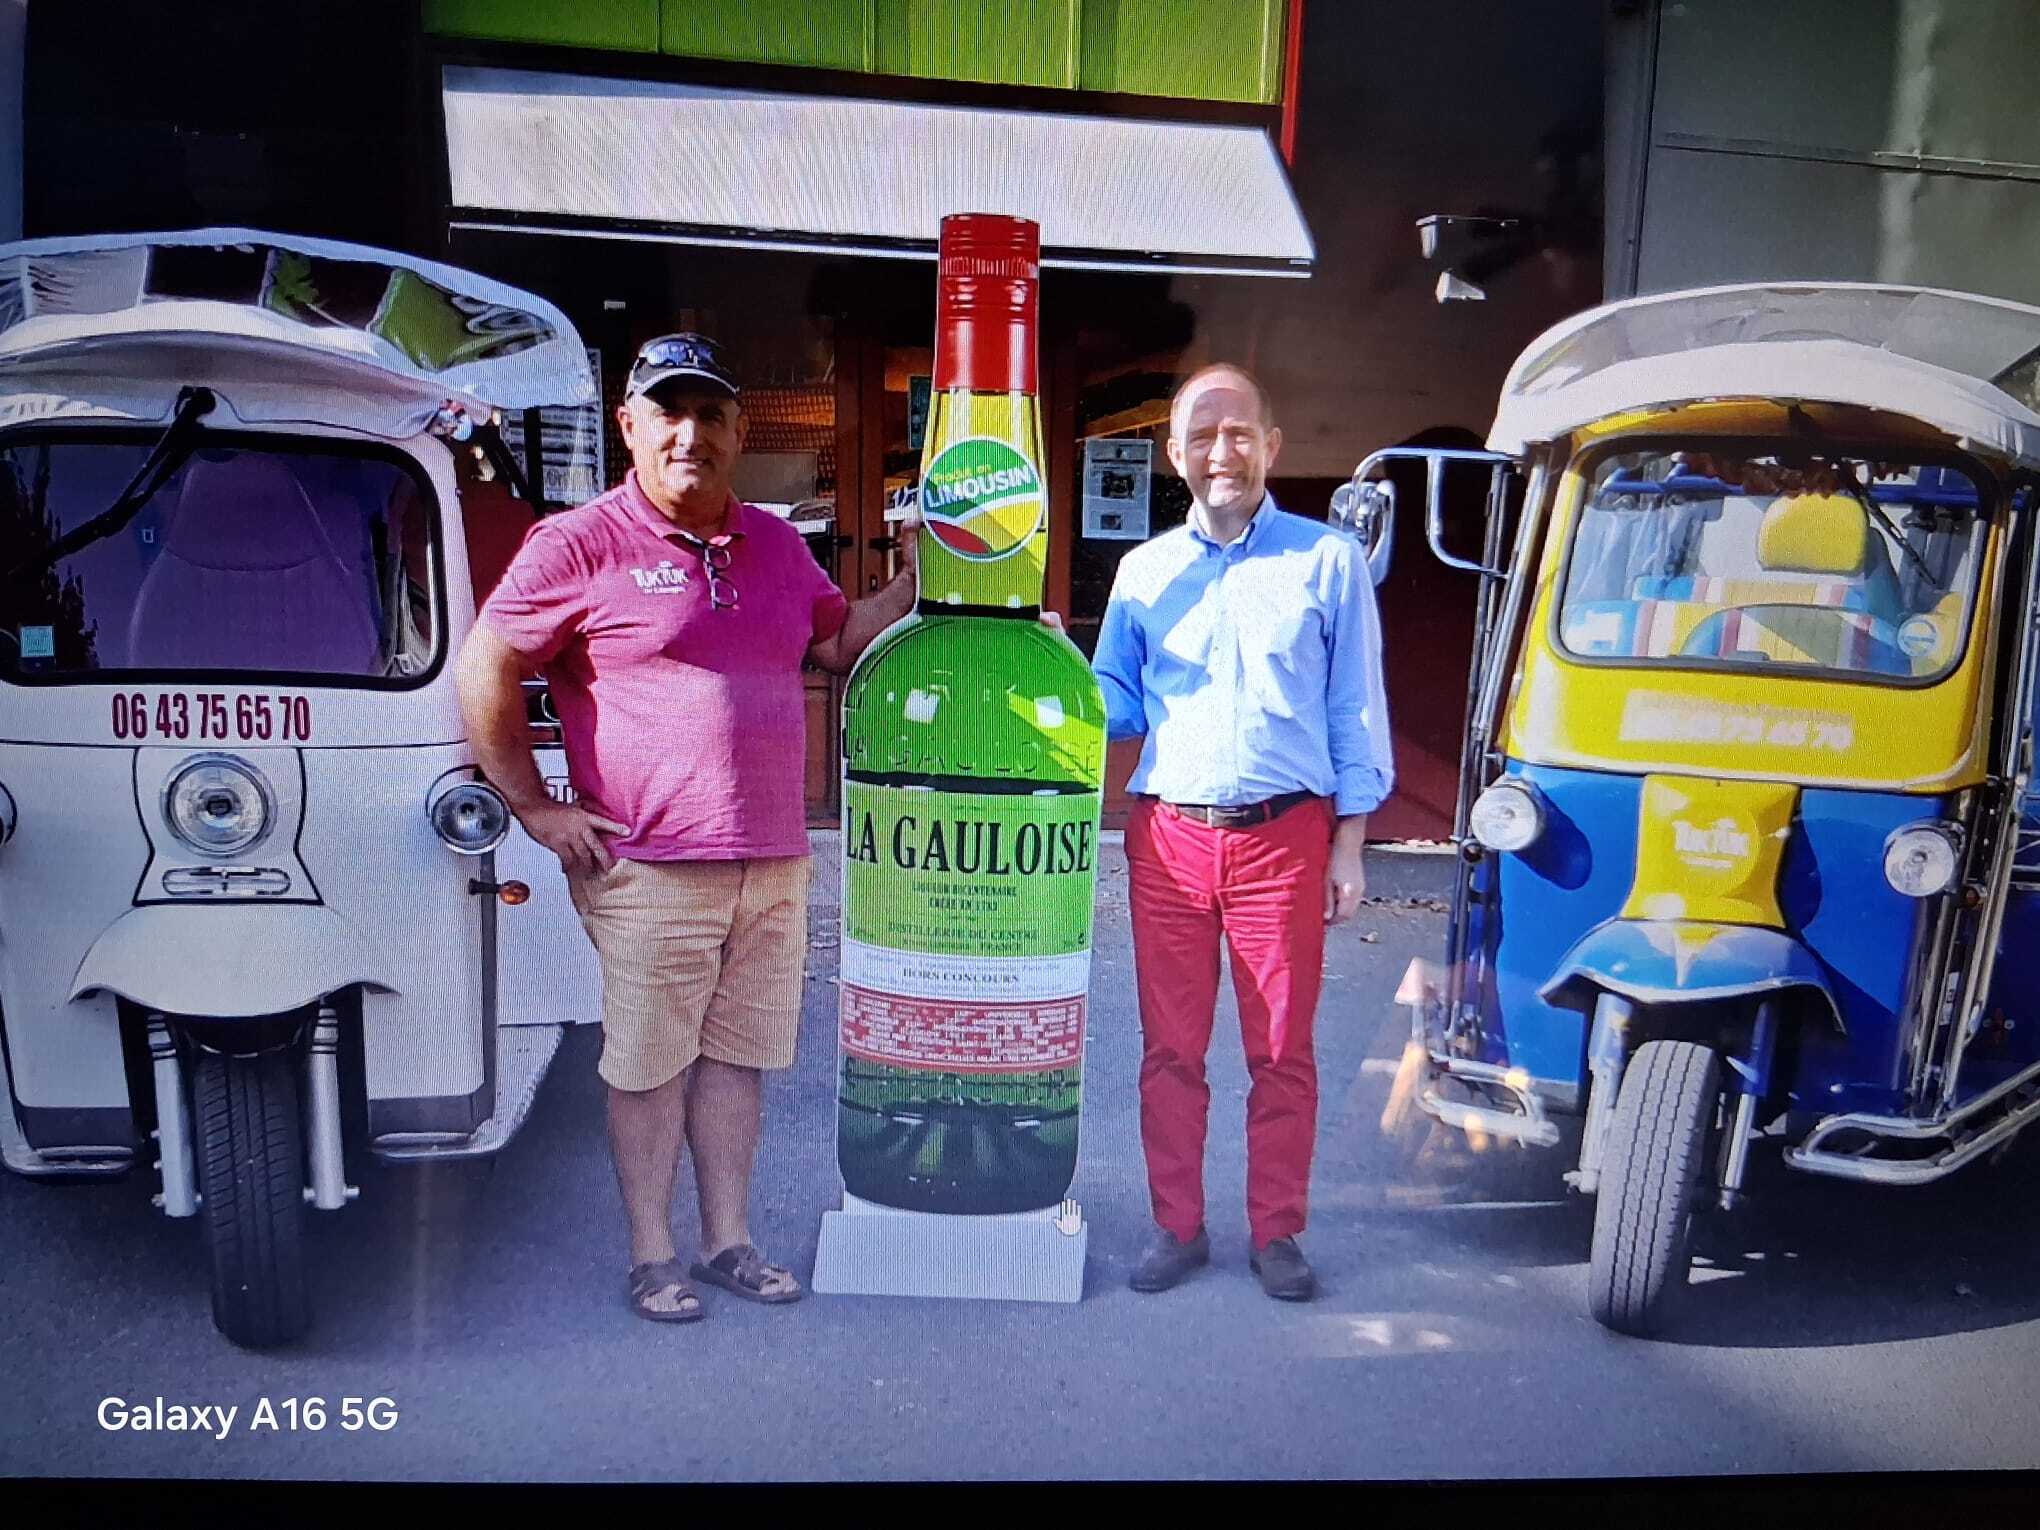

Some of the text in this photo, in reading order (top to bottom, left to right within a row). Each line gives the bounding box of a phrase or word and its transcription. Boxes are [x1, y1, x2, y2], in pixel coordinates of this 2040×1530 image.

[925, 464, 1032, 508] LIMOUSIN
[112, 692, 311, 741] 06 43 75 65 70
[846, 806, 1093, 876] LA GAULOISE
[888, 921, 965, 939] DISTILLERIE
[968, 929, 987, 940] DU
[902, 967, 940, 980] HORS
[943, 970, 1020, 983] CONCOURS
